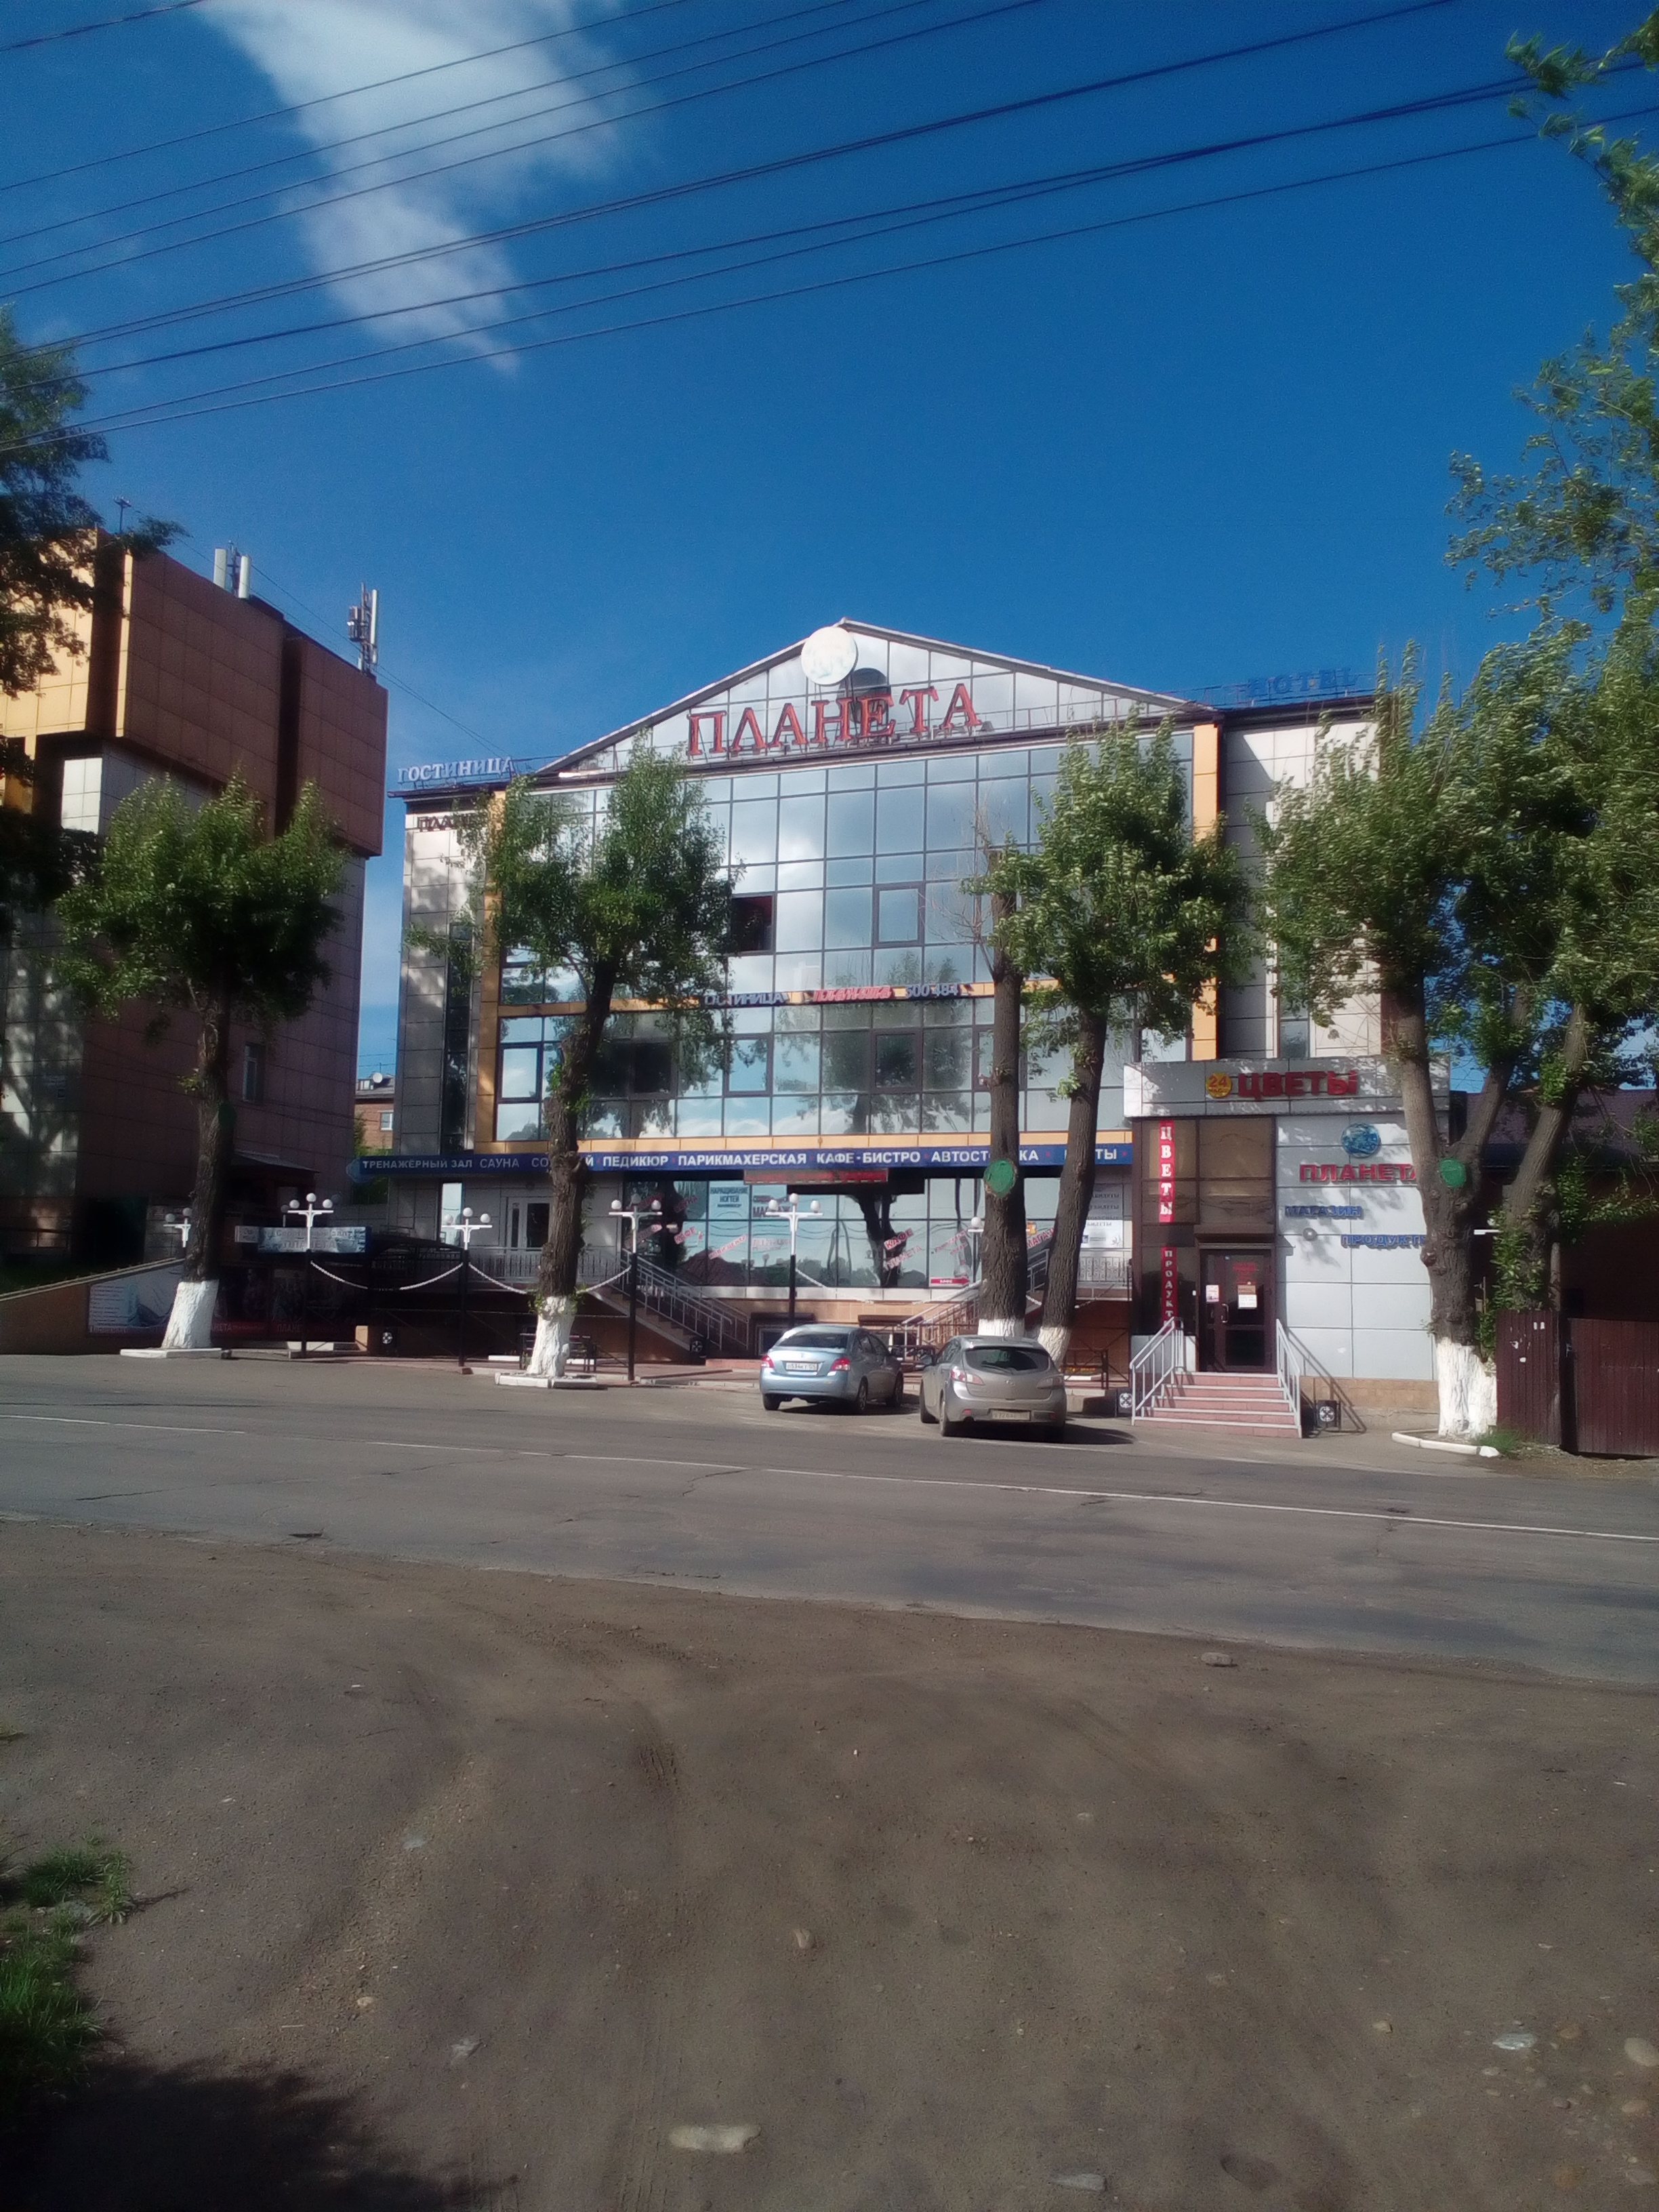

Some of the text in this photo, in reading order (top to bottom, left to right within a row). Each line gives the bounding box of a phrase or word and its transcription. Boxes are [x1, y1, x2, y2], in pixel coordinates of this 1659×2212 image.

[687, 683, 983, 756] ПЛАНЕТА
[398, 756, 514, 783] ГОСТИНИЦА
[704, 992, 784, 1006] ОСТИНИЦА
[1208, 1075, 1227, 1087] 24
[1238, 1070, 1358, 1101] ЦВЕТЫ
[451, 1159, 473, 1168] ЗАЛ
[479, 1158, 520, 1168] САУНА
[602, 1155, 669, 1168] ПЕДИКЮР
[678, 1153, 806, 1167] ПАРИКМАХЕРСКАЯ
[930, 1149, 1039, 1164] АВТОСТКА
[1160, 1126, 1173, 1215] ЦВЕТЫ
[1285, 1206, 1363, 1218] МАГАЗИН
